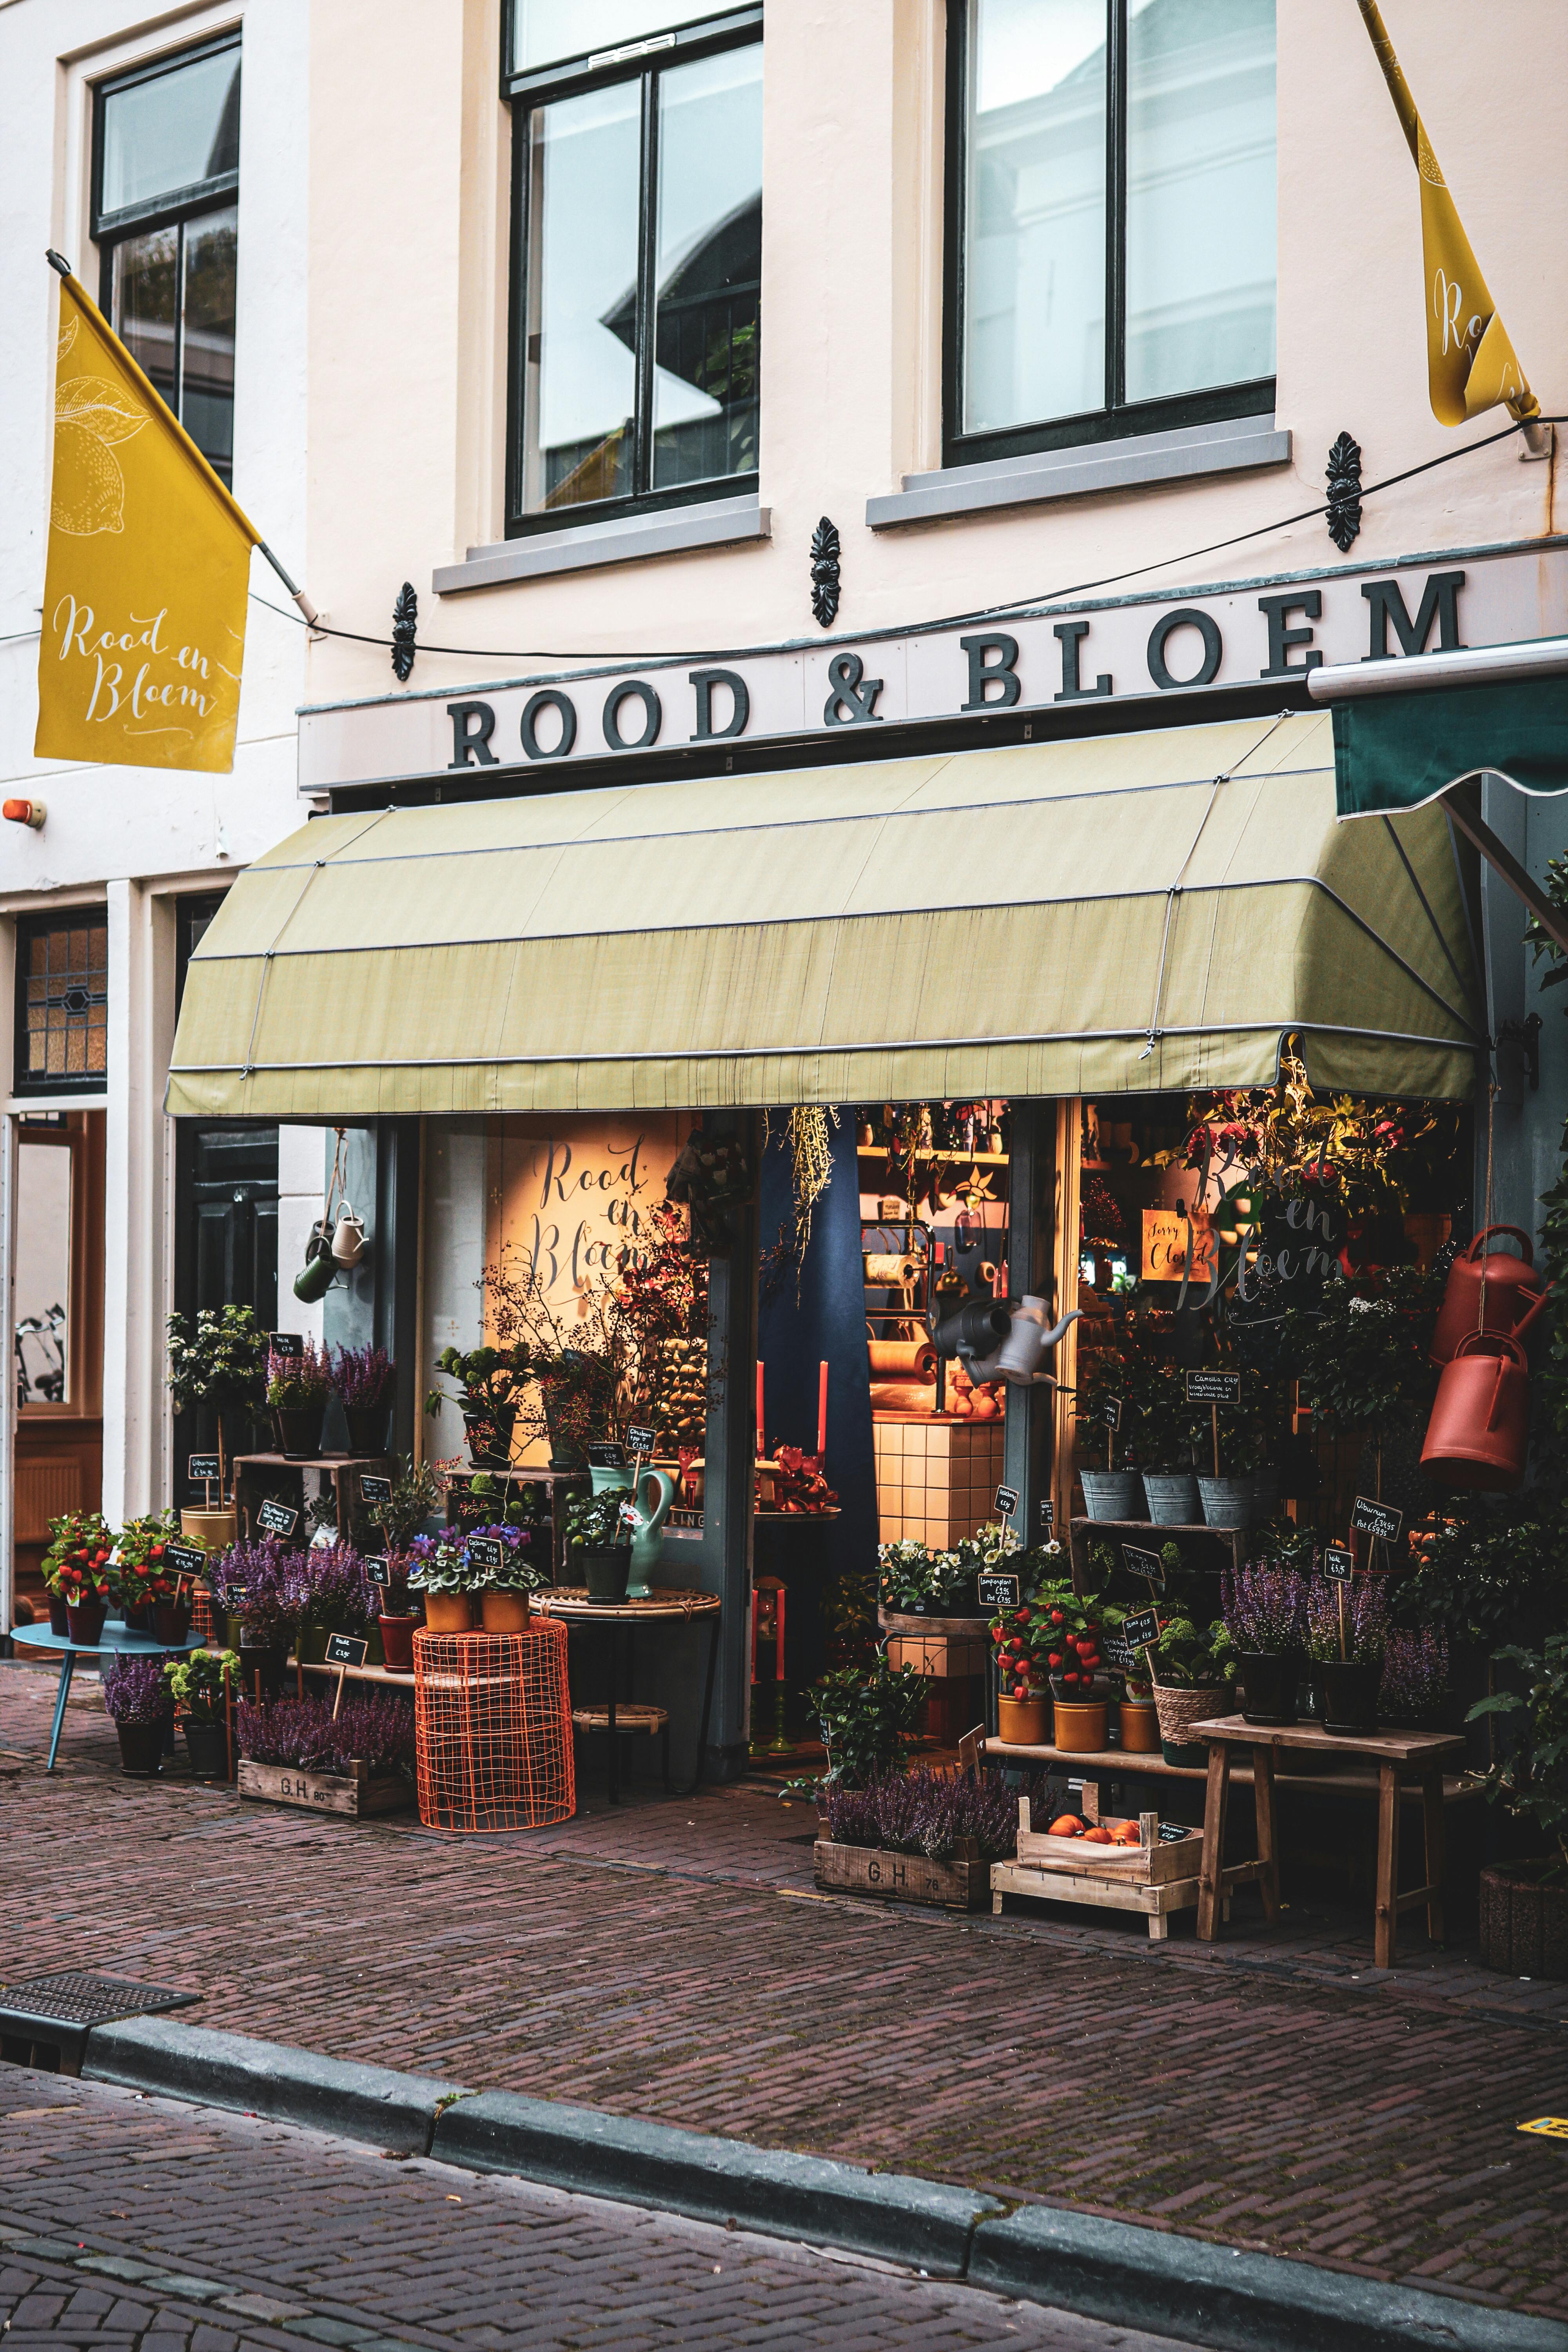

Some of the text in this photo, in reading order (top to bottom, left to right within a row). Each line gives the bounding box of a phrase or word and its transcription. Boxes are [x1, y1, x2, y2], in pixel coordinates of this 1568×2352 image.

[53, 594, 210, 679] Rood en
[85, 652, 218, 722] Bloem
[447, 570, 1468, 770] ROOD & BLOEM
[533, 1134, 648, 1209] Rood
[1176, 1122, 1340, 1210] Rood
[600, 1199, 647, 1236] en
[1148, 1222, 1180, 1243] Sorry
[1275, 1198, 1336, 1242] en
[528, 1214, 648, 1294] Bloem
[1176, 1216, 1361, 1311] Bloem
[1357, 1499, 1386, 1519] Viburnum
[1357, 1519, 1367, 1528] Pot
[469, 1539, 487, 1548] Cyclamen
[981, 1577, 1011, 1587] Lampionplant
[314, 1791, 325, 1802] 80
[925, 1877, 939, 1891] 76
